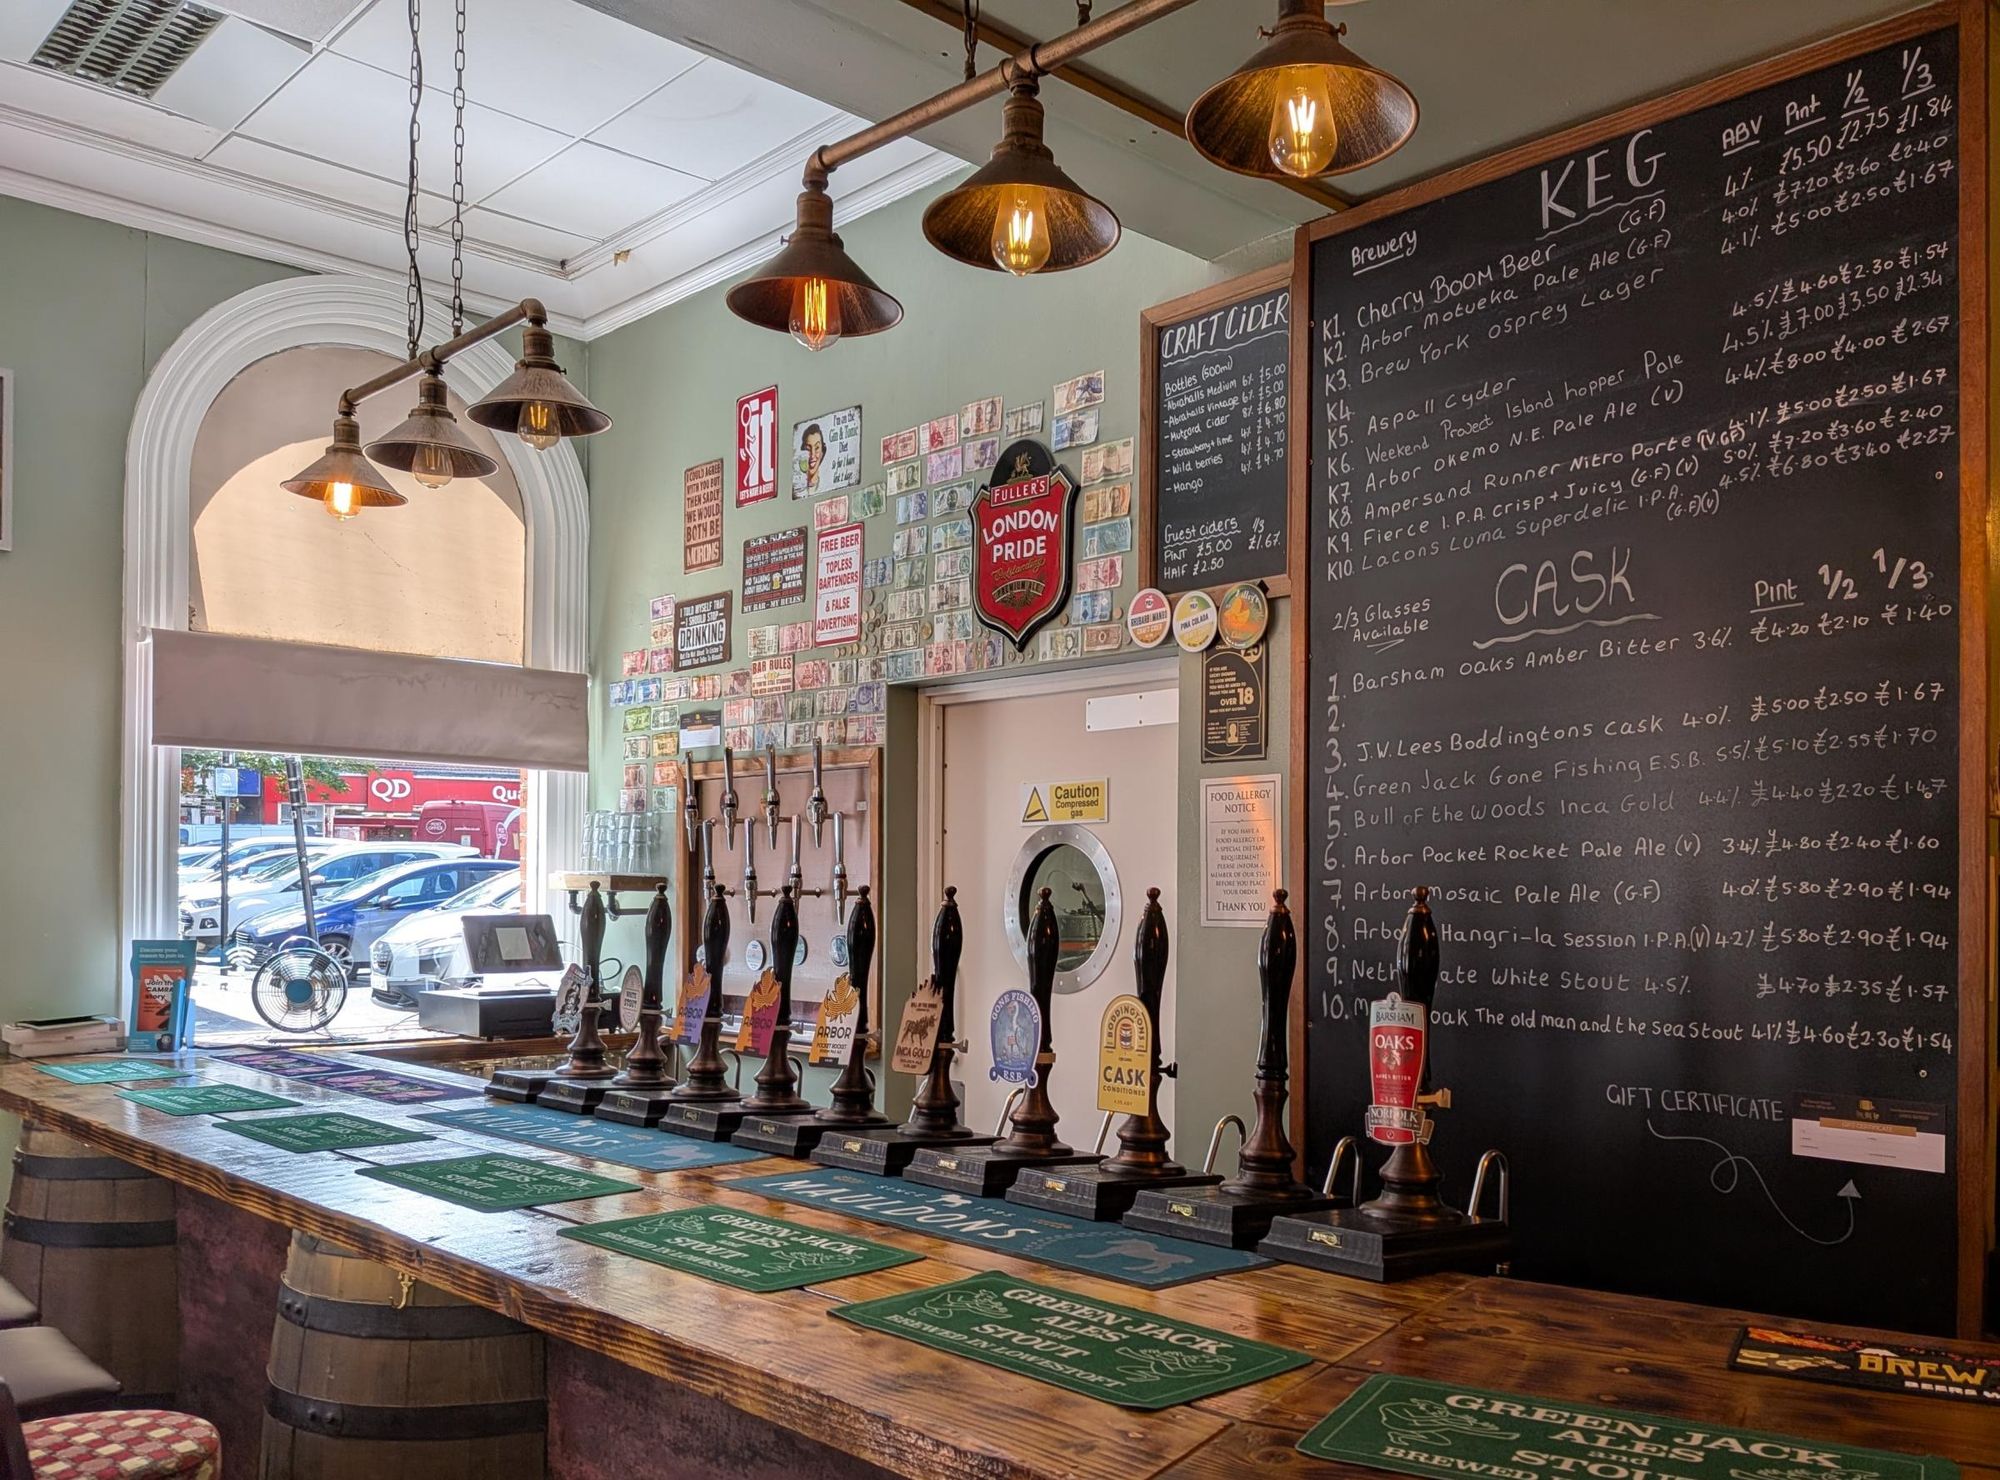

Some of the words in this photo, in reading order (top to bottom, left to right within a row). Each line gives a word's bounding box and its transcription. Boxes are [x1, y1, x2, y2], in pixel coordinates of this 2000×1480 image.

[1540, 129, 1666, 229] KEG
[1722, 115, 1762, 148] ABV
[1785, 93, 1821, 125] Pint
[1843, 69, 1869, 108] 1/2
[1902, 46, 1933, 93] 1/3
[1357, 288, 1424, 328] Cherry
[1500, 243, 1557, 279] Beer
[1725, 166, 1754, 197] 4%
[1780, 135, 1831, 175] £5.50
[1836, 106, 1890, 150] £2.75
[1896, 94, 1952, 134] £1.84
[1351, 229, 1417, 268] Brewery
[1360, 325, 1413, 355] Arbor
[1534, 266, 1580, 291] Pale
[1589, 249, 1620, 271] Ale
[1888, 136, 1948, 162] £2.40
[1162, 311, 1225, 359] CRAFT
[1361, 357, 1410, 384] Brew
[1581, 269, 1664, 308] Lager
[1164, 374, 1198, 397] Bottles
[1207, 379, 1237, 397] Medium
[1206, 413, 1231, 429] Cider
[1365, 466, 1421, 493] Arbor
[1553, 414, 1594, 436] Pale
[1604, 400, 1637, 422] Ale
[1651, 380, 1684, 406] (V)
[690, 468, 705, 481] COULD
[705, 463, 721, 477] AGREE
[1172, 461, 1193, 475] Wild
[703, 489, 720, 505] SADLY
[994, 478, 1047, 505] FULLER'S
[1173, 477, 1204, 493] Mango
[1364, 483, 1472, 521] Ampersand
[1484, 462, 1561, 491] Runner
[1569, 450, 1624, 473] Nitro
[687, 511, 697, 524] WE
[698, 507, 720, 521] WOULD
[982, 509, 1059, 545] LONDON
[687, 521, 708, 543] BOTH
[709, 518, 720, 535] BE
[821, 538, 839, 553] FREE
[841, 533, 860, 549] BEER
[1164, 524, 1197, 543] Guest
[1362, 541, 1440, 571] Lacons
[1516, 498, 1629, 536] Superdelic
[1363, 520, 1430, 547] Fierce
[687, 541, 720, 567] MORONS
[992, 535, 1047, 564] PRIDE
[826, 557, 853, 575] TOPLESS
[1192, 557, 1225, 576] £2.50
[1818, 564, 1858, 600] 1/2
[1872, 548, 1929, 590] 1/3
[819, 571, 859, 590] BARTENDERS
[1496, 547, 1635, 625] CASK
[831, 597, 850, 610] FALSE
[1332, 605, 1359, 631] 2/3
[1365, 597, 1432, 624] Glasses
[817, 613, 858, 632] ADVERTISING
[1353, 617, 1430, 643] Available
[680, 622, 724, 650] DRINKING
[752, 660, 767, 674] BAR
[769, 657, 792, 670] RULES
[1352, 665, 1445, 693] Barsham
[1525, 648, 1589, 668] Amber
[1599, 637, 1679, 657] Bitter
[1695, 625, 1732, 649] 3.6%
[1750, 616, 1809, 643] £4.20
[1220, 697, 1238, 706] OVER
[1237, 686, 1255, 705] 18
[1397, 737, 1443, 757] Lees
[1450, 721, 1593, 751] Boddingtons
[1421, 769, 1476, 791] Jack
[1489, 765, 1543, 786] Gone
[1554, 756, 1642, 782] Fishing
[371, 778, 411, 803] QD
[1055, 784, 1099, 800] Caution
[1211, 792, 1235, 802] FOOD
[1236, 790, 1271, 801] ALLERGY
[1055, 798, 1099, 809] Compressed
[1070, 809, 1083, 819] gas
[1225, 803, 1256, 814] NOTICE
[1354, 845, 1413, 866] Arbor
[1423, 845, 1487, 864] Pocket
[1494, 843, 1569, 862] Rocket
[1581, 841, 1623, 858] Pale
[1634, 837, 1666, 856] Ale
[1765, 828, 1821, 857] £4.80
[1825, 831, 1880, 851] £2.40
[1216, 900, 1247, 912] THANK
[1248, 902, 1266, 912] YOU
[1491, 967, 1550, 987] White
[1560, 970, 1631, 992] Stout
[679, 1007, 703, 1019] ARBOR
[991, 994, 1010, 1021] GONE
[1011, 992, 1040, 1024] FISHING
[1375, 1011, 1415, 1025] BARSHAM
[1475, 1008, 1505, 1025] The
[1511, 1009, 1536, 1029] old
[743, 1016, 772, 1030] ARBOR
[816, 1026, 852, 1040] ARBOR
[1107, 1004, 1146, 1042] BODDINGTONS
[912, 1046, 931, 1059] GOLD
[1375, 1034, 1415, 1051] OAKS
[1103, 1065, 1146, 1088] CASK
[1102, 1085, 1146, 1097] CONDITIONED
[1605, 1083, 1652, 1109] GIFT
[1661, 1088, 1785, 1122] CERTIFICATE
[1370, 1107, 1419, 1124] NORFOLK
[458, 1112, 620, 1148] MAULDONS
[763, 1178, 1040, 1240] MAULDONS
[709, 1214, 801, 1238] GREEN
[790, 1235, 869, 1255] JACK
[720, 1231, 791, 1249] ALES
[663, 1237, 749, 1259] STOUT
[1003, 1288, 1123, 1326] GREEN
[1124, 1320, 1234, 1356] JACK
[1031, 1313, 1129, 1343] ALES
[1035, 1328, 1075, 1341] and
[884, 1314, 967, 1342] BREWED
[967, 1338, 997, 1351] IN
[996, 1346, 1126, 1389] LOWESTOFT
[971, 1322, 1091, 1360] STOUT
[1859, 1354, 1987, 1386] BREW
[1446, 1394, 1661, 1439] GREEN
[1673, 1431, 1842, 1470] JACK
[1548, 1430, 1706, 1464] ALES
[1588, 1450, 1651, 1466] and
